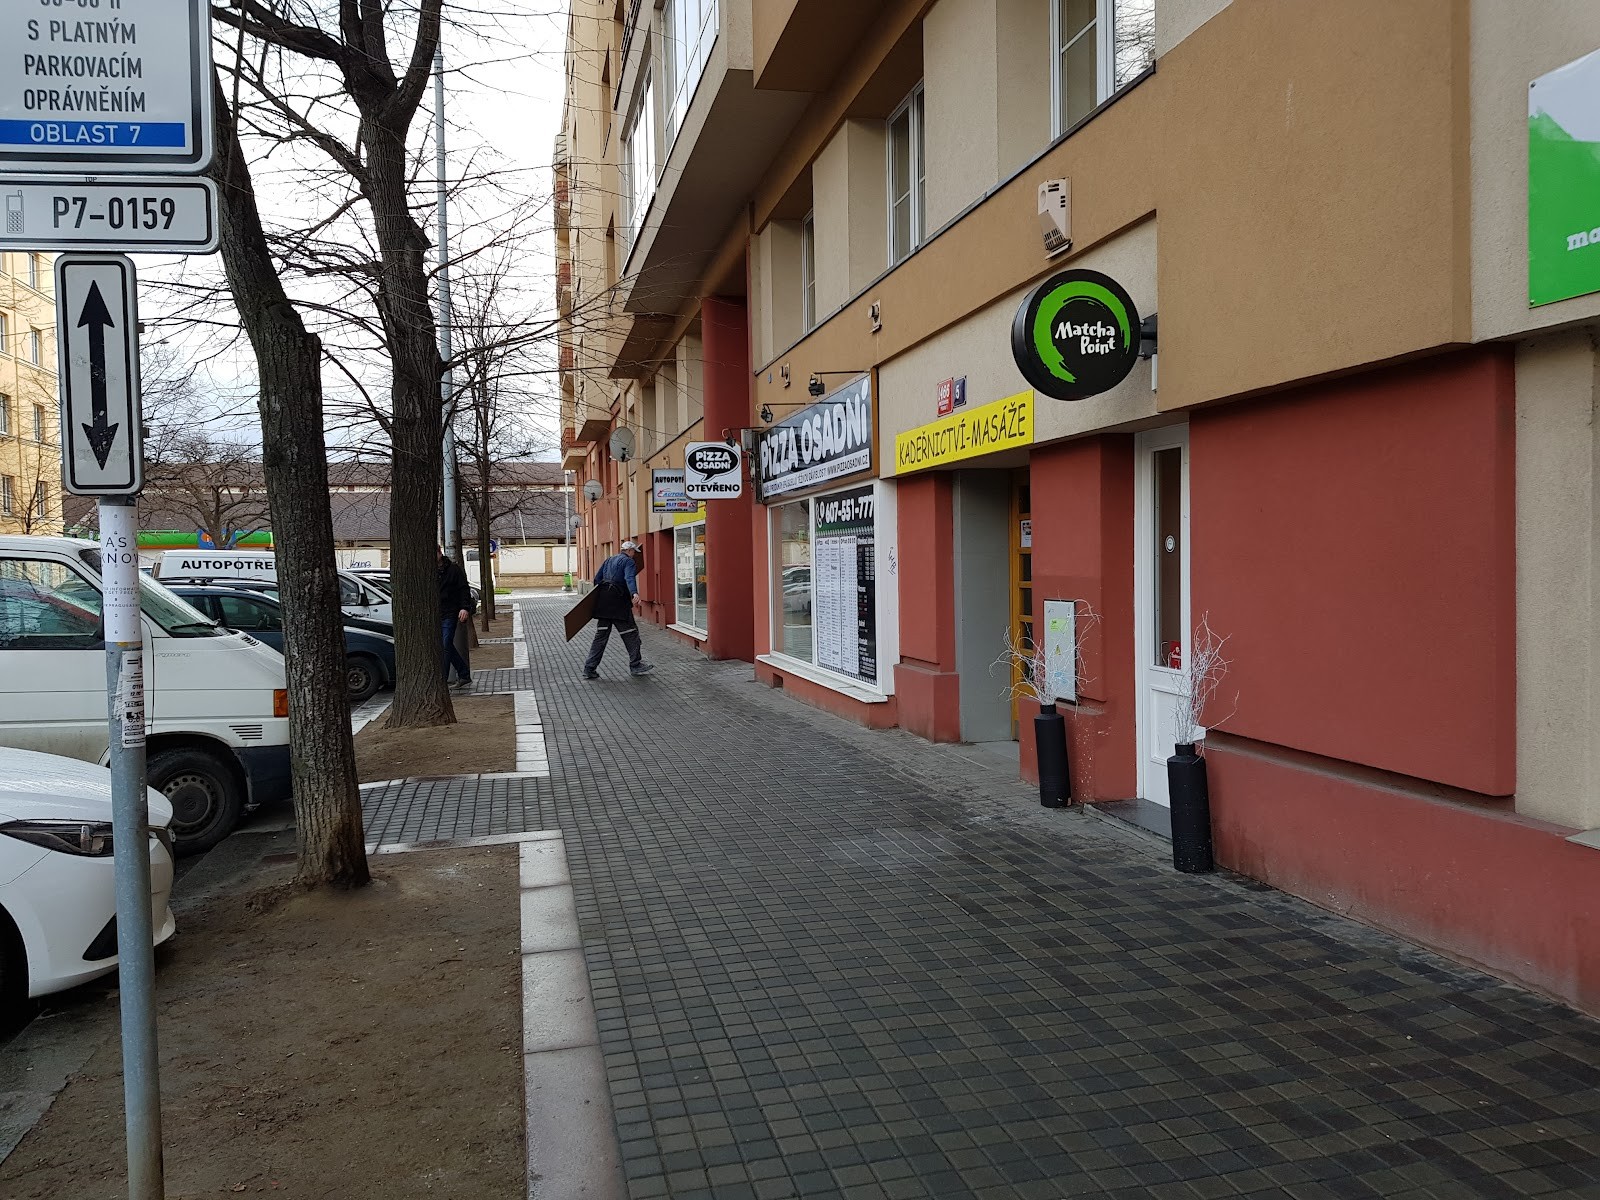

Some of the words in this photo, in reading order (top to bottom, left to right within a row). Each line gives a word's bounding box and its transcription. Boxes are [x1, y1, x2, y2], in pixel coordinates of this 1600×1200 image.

[27, 19, 40, 41] S
[49, 17, 136, 44] PLATNÝM
[24, 51, 142, 79] PARKOVACÍM
[23, 84, 146, 112] OPRÁVNĚNÍM
[30, 123, 119, 144] OBLAST
[129, 125, 141, 144] 7
[52, 196, 176, 230] P7-0159
[1054, 320, 1116, 339] Matcha
[1080, 335, 1116, 355] Point
[899, 402, 1026, 467] KADEŘNICTVÍ-MASÁŽE
[687, 482, 740, 492] OTEVŘENO
[825, 494, 874, 524] 607-551-777
[181, 558, 277, 570] AUTOPOTŘE
